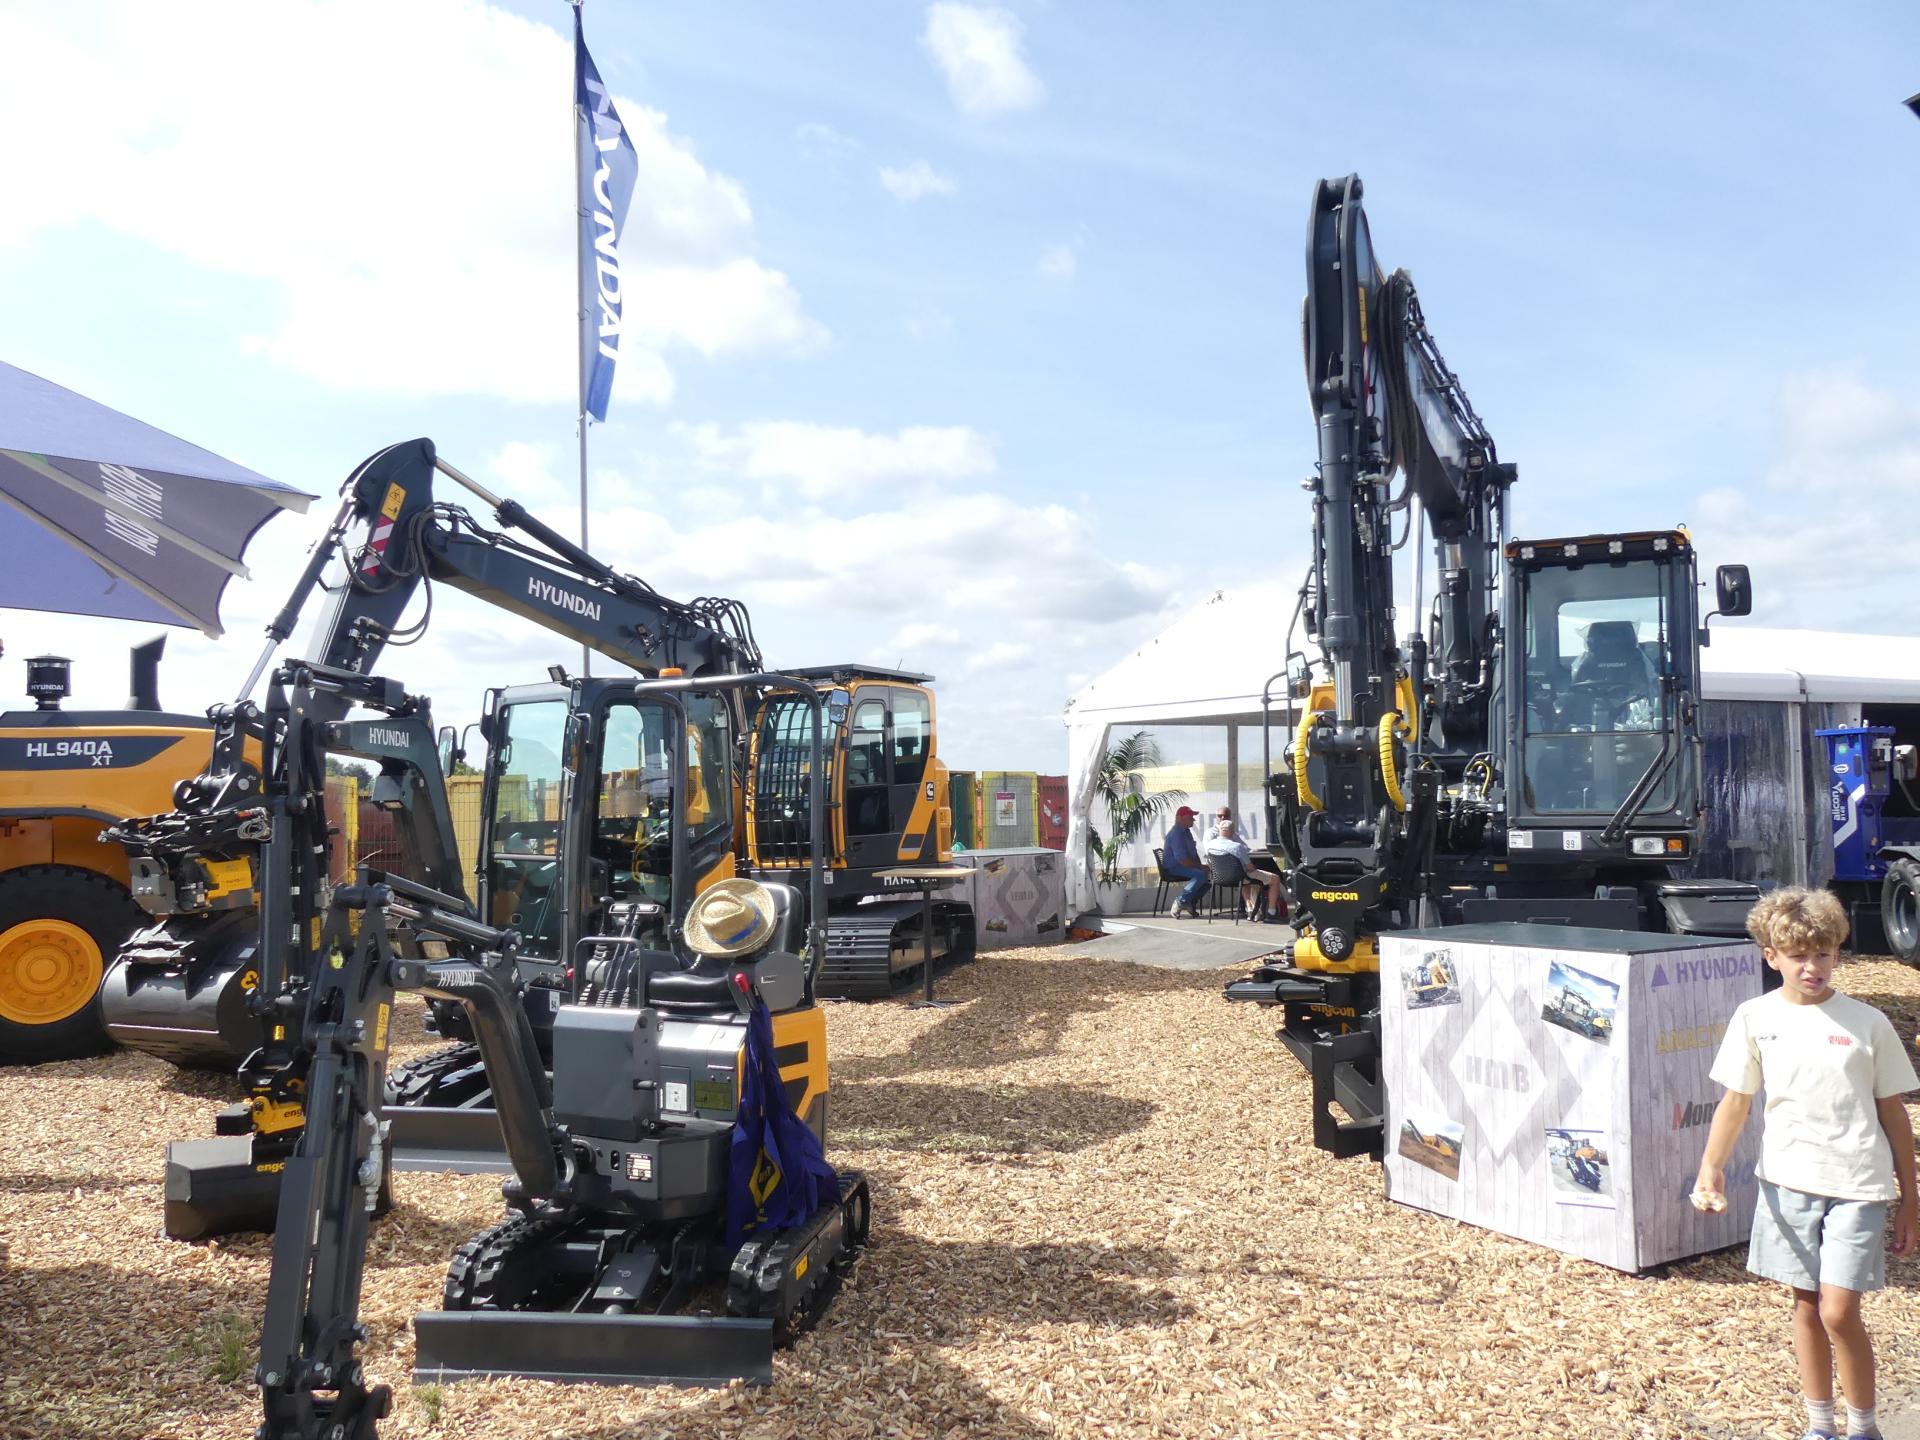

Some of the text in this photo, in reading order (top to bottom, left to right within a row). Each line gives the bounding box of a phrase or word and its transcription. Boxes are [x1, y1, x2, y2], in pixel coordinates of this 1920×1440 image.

[527, 577, 602, 622] HYUNDAI
[31, 683, 64, 692] HYUNDAI
[369, 727, 410, 749] HYUNDAI
[27, 740, 113, 758] HL940A
[92, 755, 113, 767] XT
[1311, 890, 1359, 903] engcon
[438, 969, 476, 987] HYUNDAI
[1676, 955, 1756, 984] HYUNDAI
[1466, 1055, 1530, 1094] HMB
[284, 1108, 304, 1118] eng
[256, 1162, 286, 1174] engc
